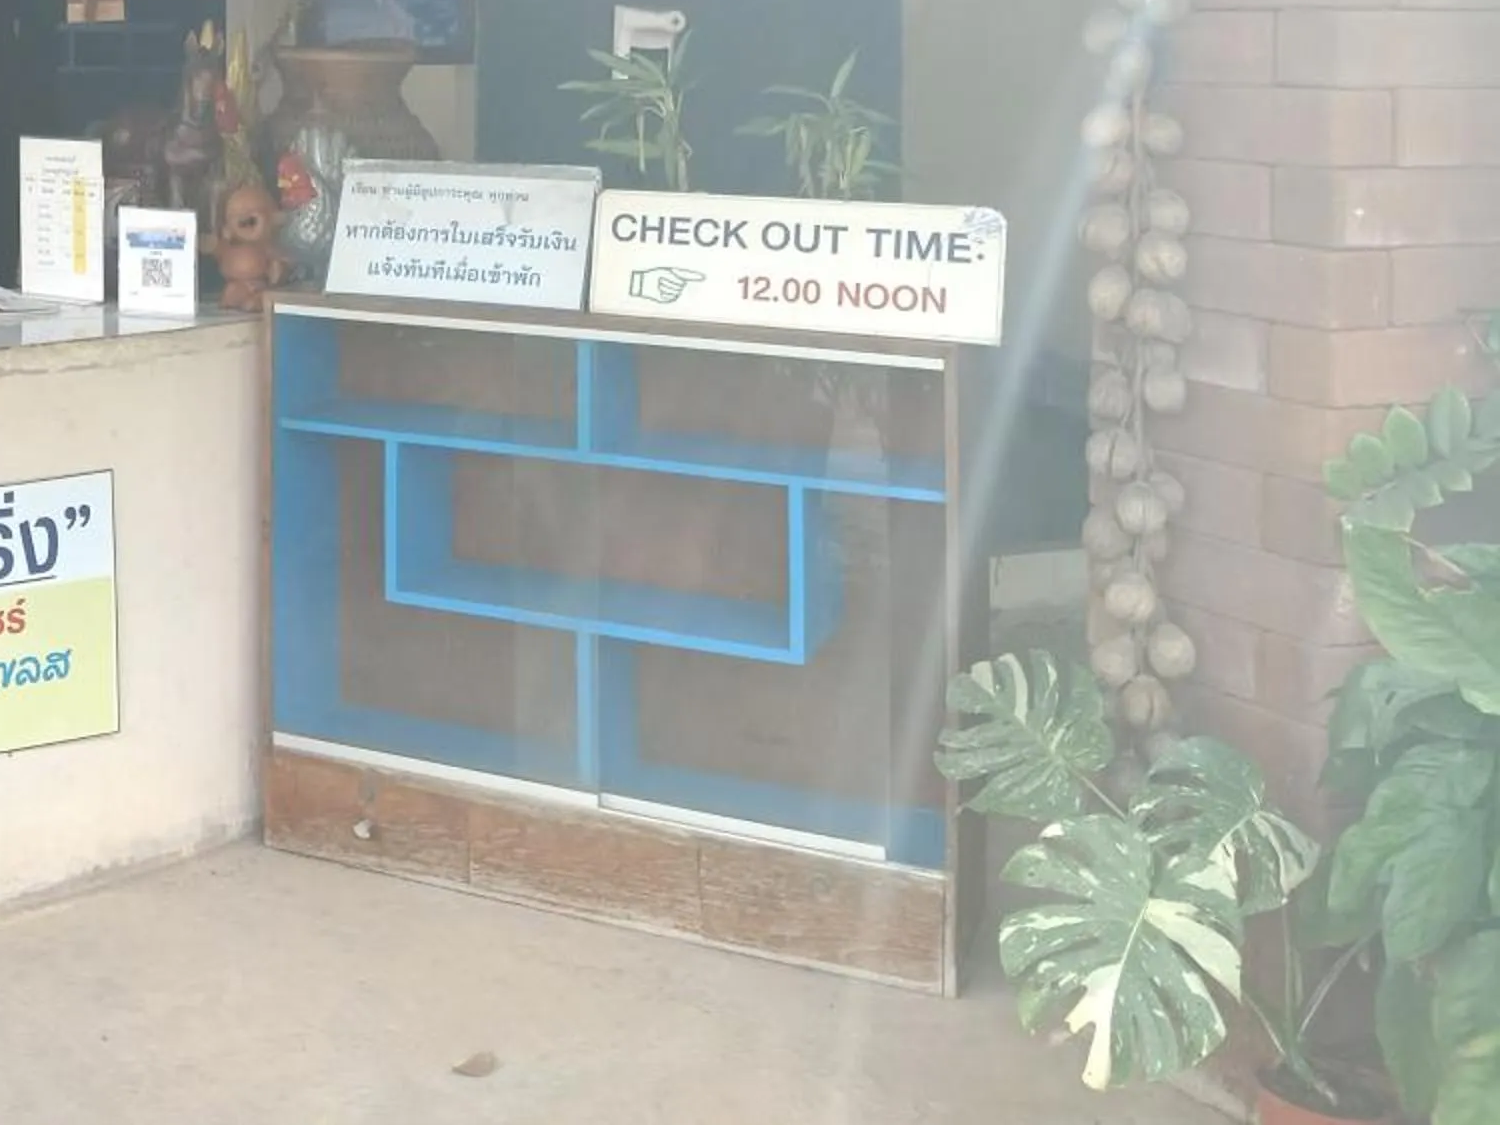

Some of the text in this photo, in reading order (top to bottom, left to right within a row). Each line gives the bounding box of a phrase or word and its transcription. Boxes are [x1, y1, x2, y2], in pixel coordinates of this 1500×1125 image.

[346, 219, 578, 251] หากต้องการใบเสร็จรับเงิน
[611, 213, 749, 249] CHECK
[761, 221, 849, 254] OUT
[367, 256, 542, 287] แจ้งทันทีเมื่อเข้าพัก
[737, 276, 947, 314] 12.00 NOON
